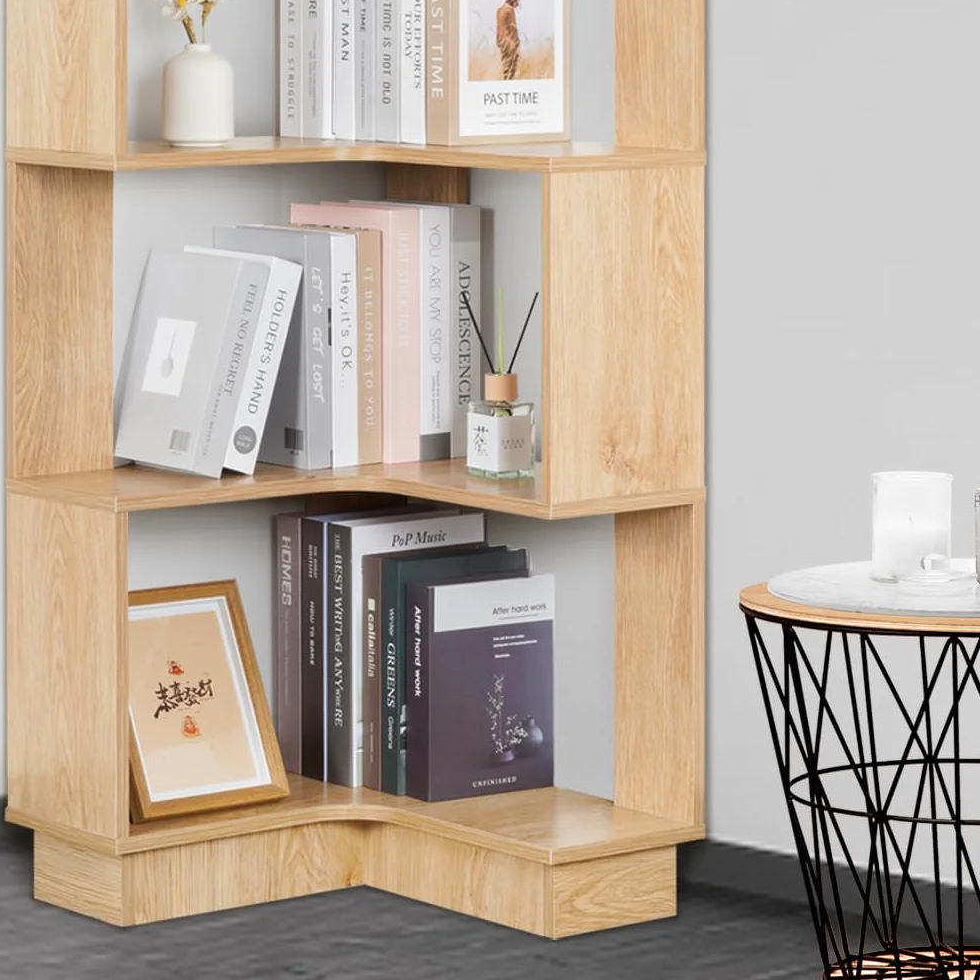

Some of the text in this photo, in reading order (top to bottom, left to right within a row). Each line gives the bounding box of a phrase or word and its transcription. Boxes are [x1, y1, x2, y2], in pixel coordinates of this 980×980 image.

[287, 35, 295, 49] TO
[341, 22, 350, 62] MAN
[405, 11, 413, 59] TODAY
[413, 27, 422, 89] EFFORTS
[431, 41, 443, 99] TIME
[287, 58, 295, 119] STRUGGLE
[382, 81, 392, 104] OLD
[483, 91, 540, 106] PAST TIME
[428, 223, 441, 258] YOU
[428, 296, 441, 322] MY
[222, 283, 259, 397] FEEL NO REGRET
[247, 289, 287, 415] HOLDER'S HAND
[311, 266, 325, 403] LET'S GET LOST
[428, 327, 442, 364] STOP
[458, 261, 471, 405] ADOLESCENCE
[415, 529, 448, 545] Music
[281, 535, 292, 606] HOMES
[334, 554, 343, 594] BEST
[492, 607, 510, 615] After
[511, 604, 529, 613] hard
[413, 605, 422, 697] After hard work
[386, 642, 396, 709] GREENS
[472, 775, 518, 788] UNFINISHED
